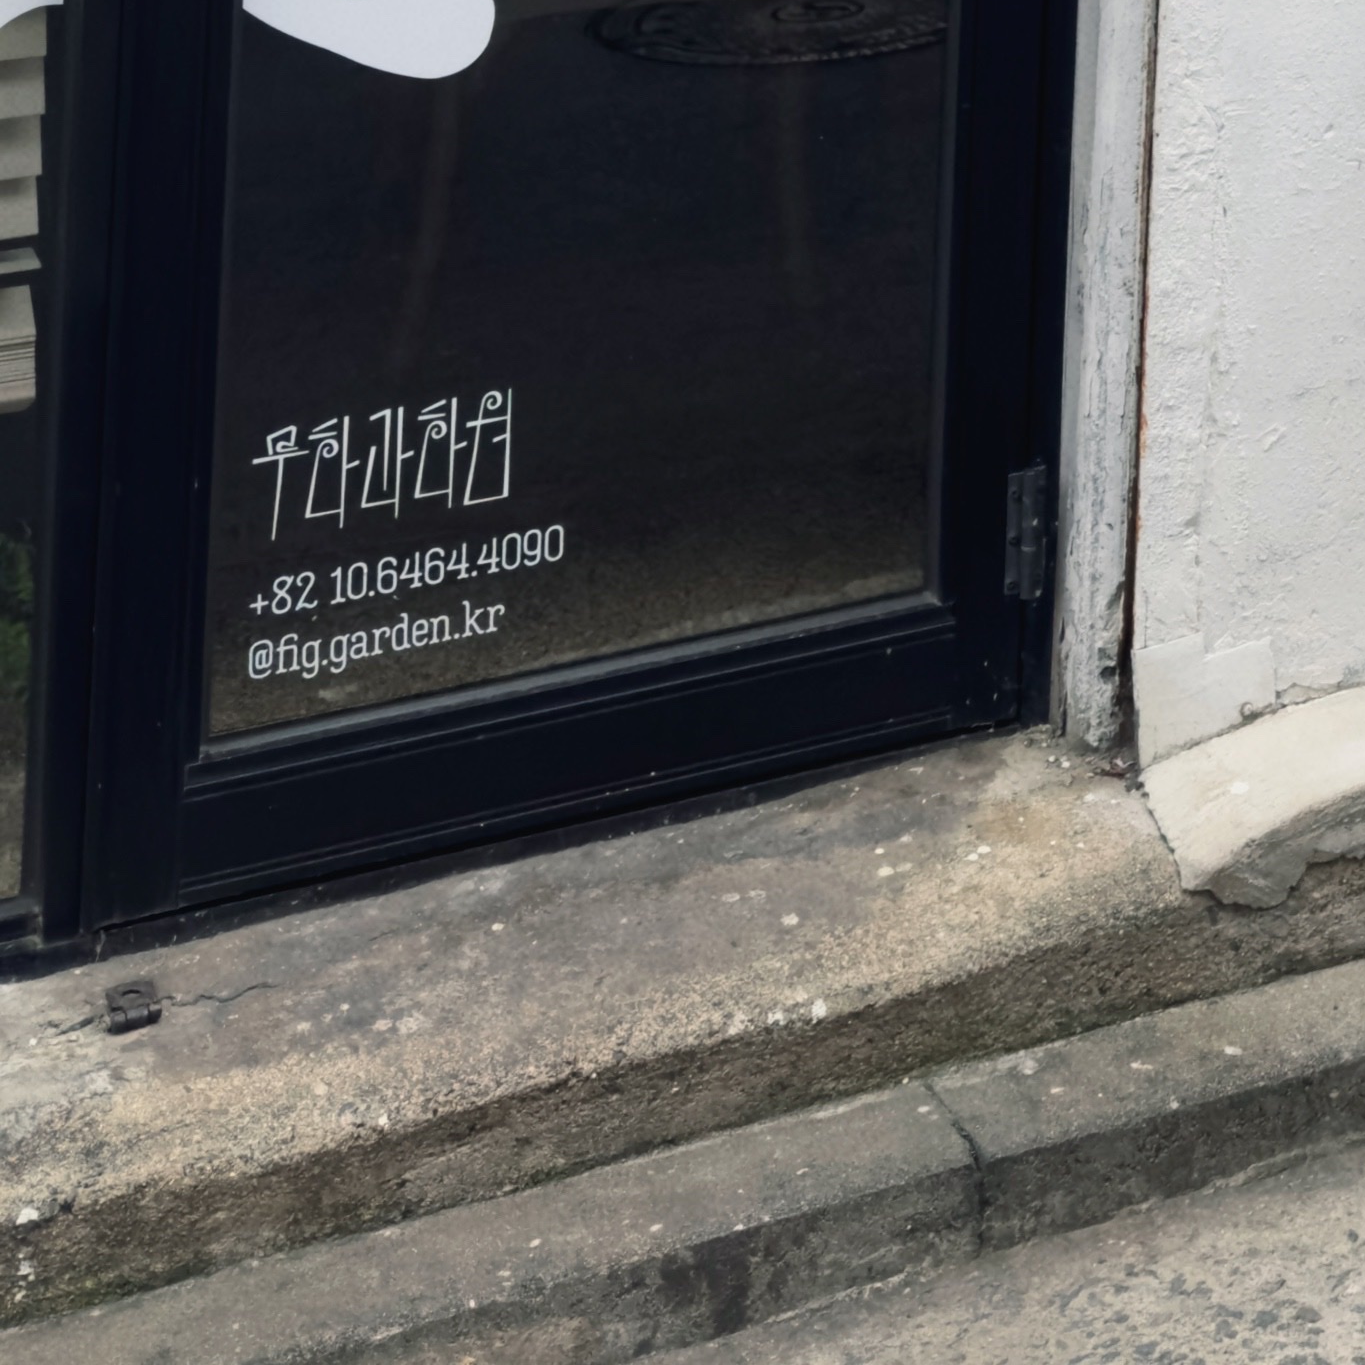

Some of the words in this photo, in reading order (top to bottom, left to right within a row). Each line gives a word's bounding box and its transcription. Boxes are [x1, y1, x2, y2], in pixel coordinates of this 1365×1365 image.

[248, 571, 319, 616] +82
[329, 524, 565, 605] 10.6464.4090
[247, 600, 506, 680] @fig.garden.kr
